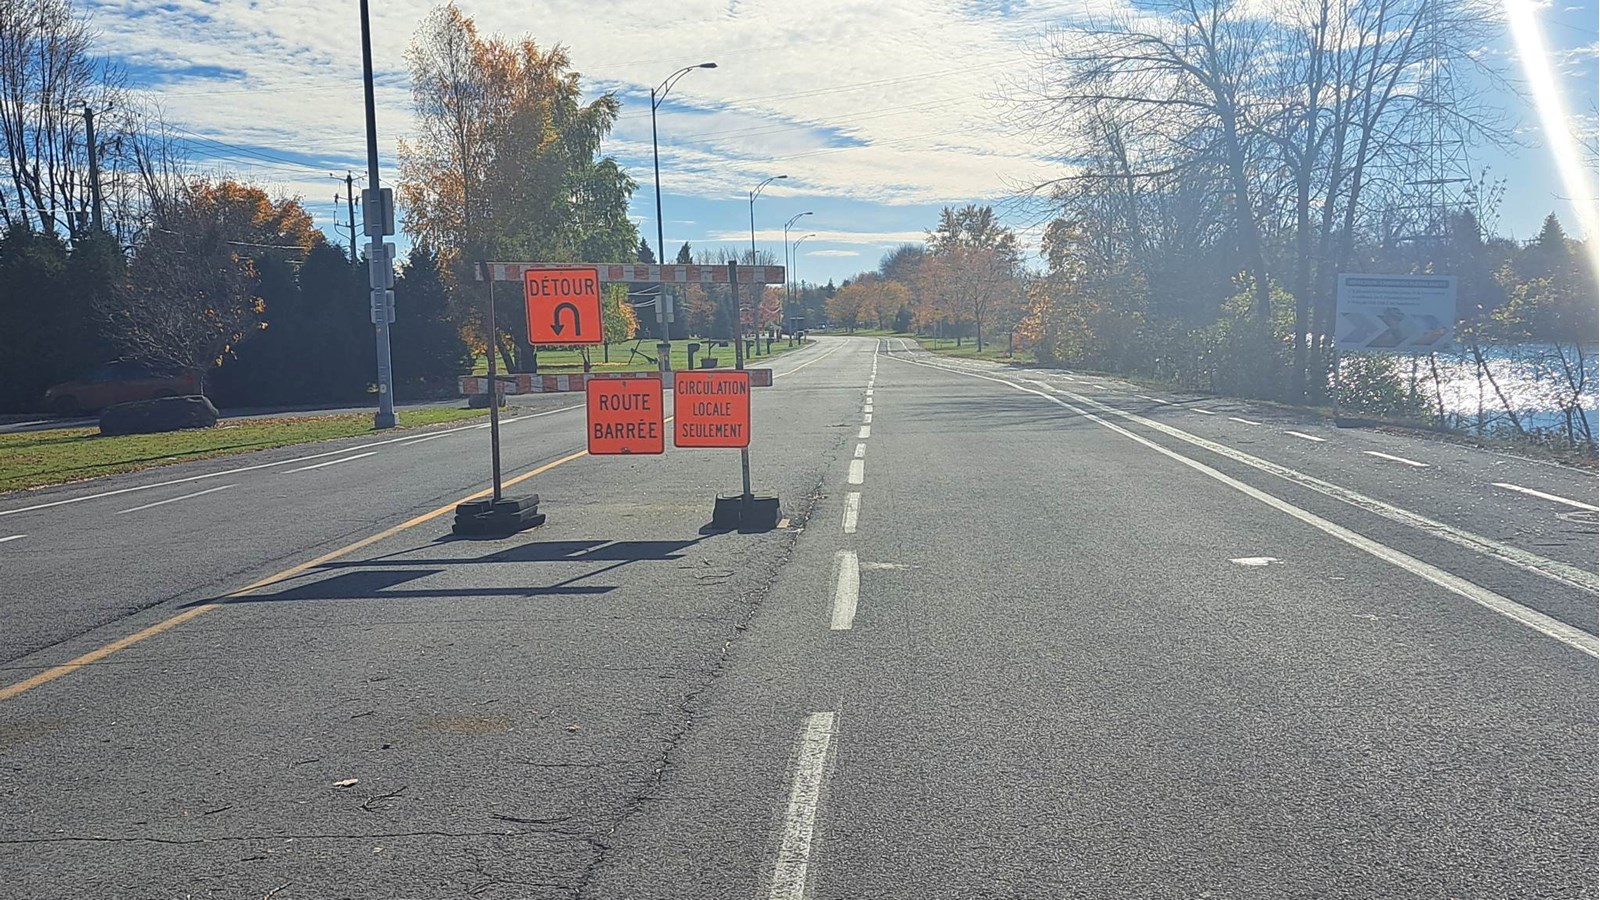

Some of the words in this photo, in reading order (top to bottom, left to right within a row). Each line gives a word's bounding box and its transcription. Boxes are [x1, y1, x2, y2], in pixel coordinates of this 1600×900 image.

[530, 276, 595, 296] DÉTOUR
[678, 380, 747, 395] CIRCULATION
[599, 394, 651, 411] ROUTE
[693, 402, 731, 417] LOCALE
[594, 420, 657, 440] BARRÉE
[682, 424, 742, 438] SEULEMENT
